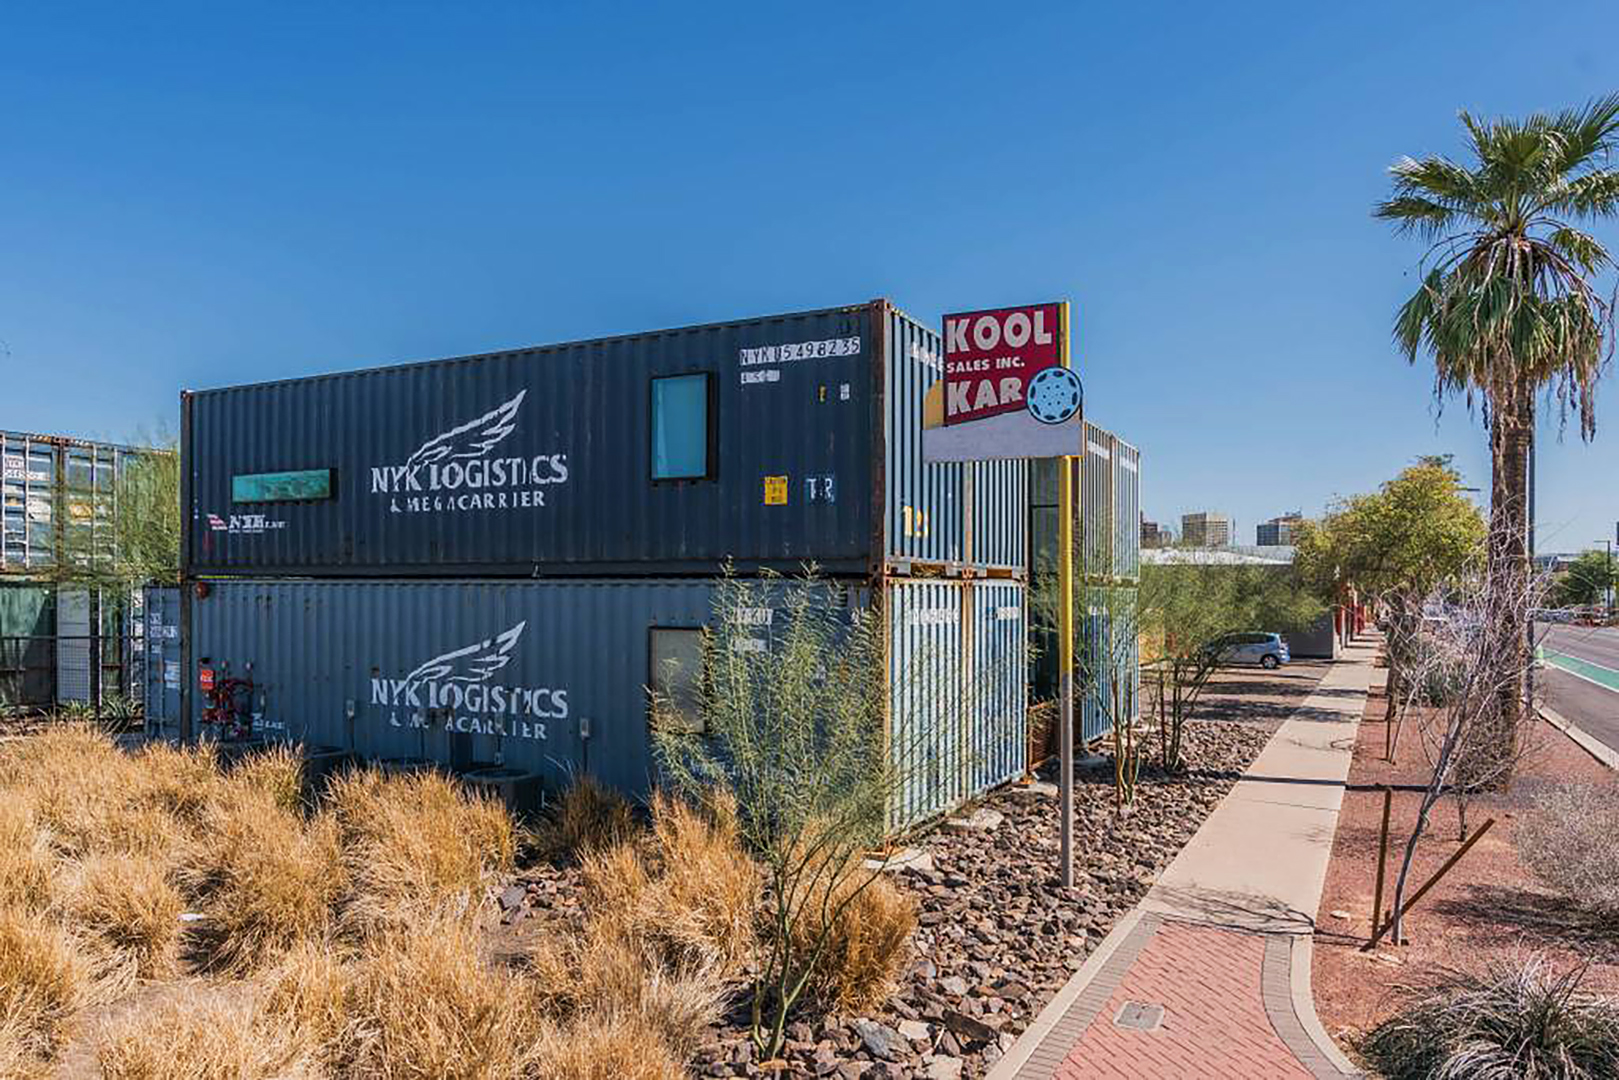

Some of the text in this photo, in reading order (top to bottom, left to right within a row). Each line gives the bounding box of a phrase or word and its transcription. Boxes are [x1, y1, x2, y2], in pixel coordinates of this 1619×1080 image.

[946, 310, 1053, 354] KOOL
[946, 355, 1026, 374] SALES INC.
[947, 377, 1023, 416] KAR
[370, 453, 569, 493] NYK LOGISTICS
[370, 678, 569, 719] NYK LOGISTICS
